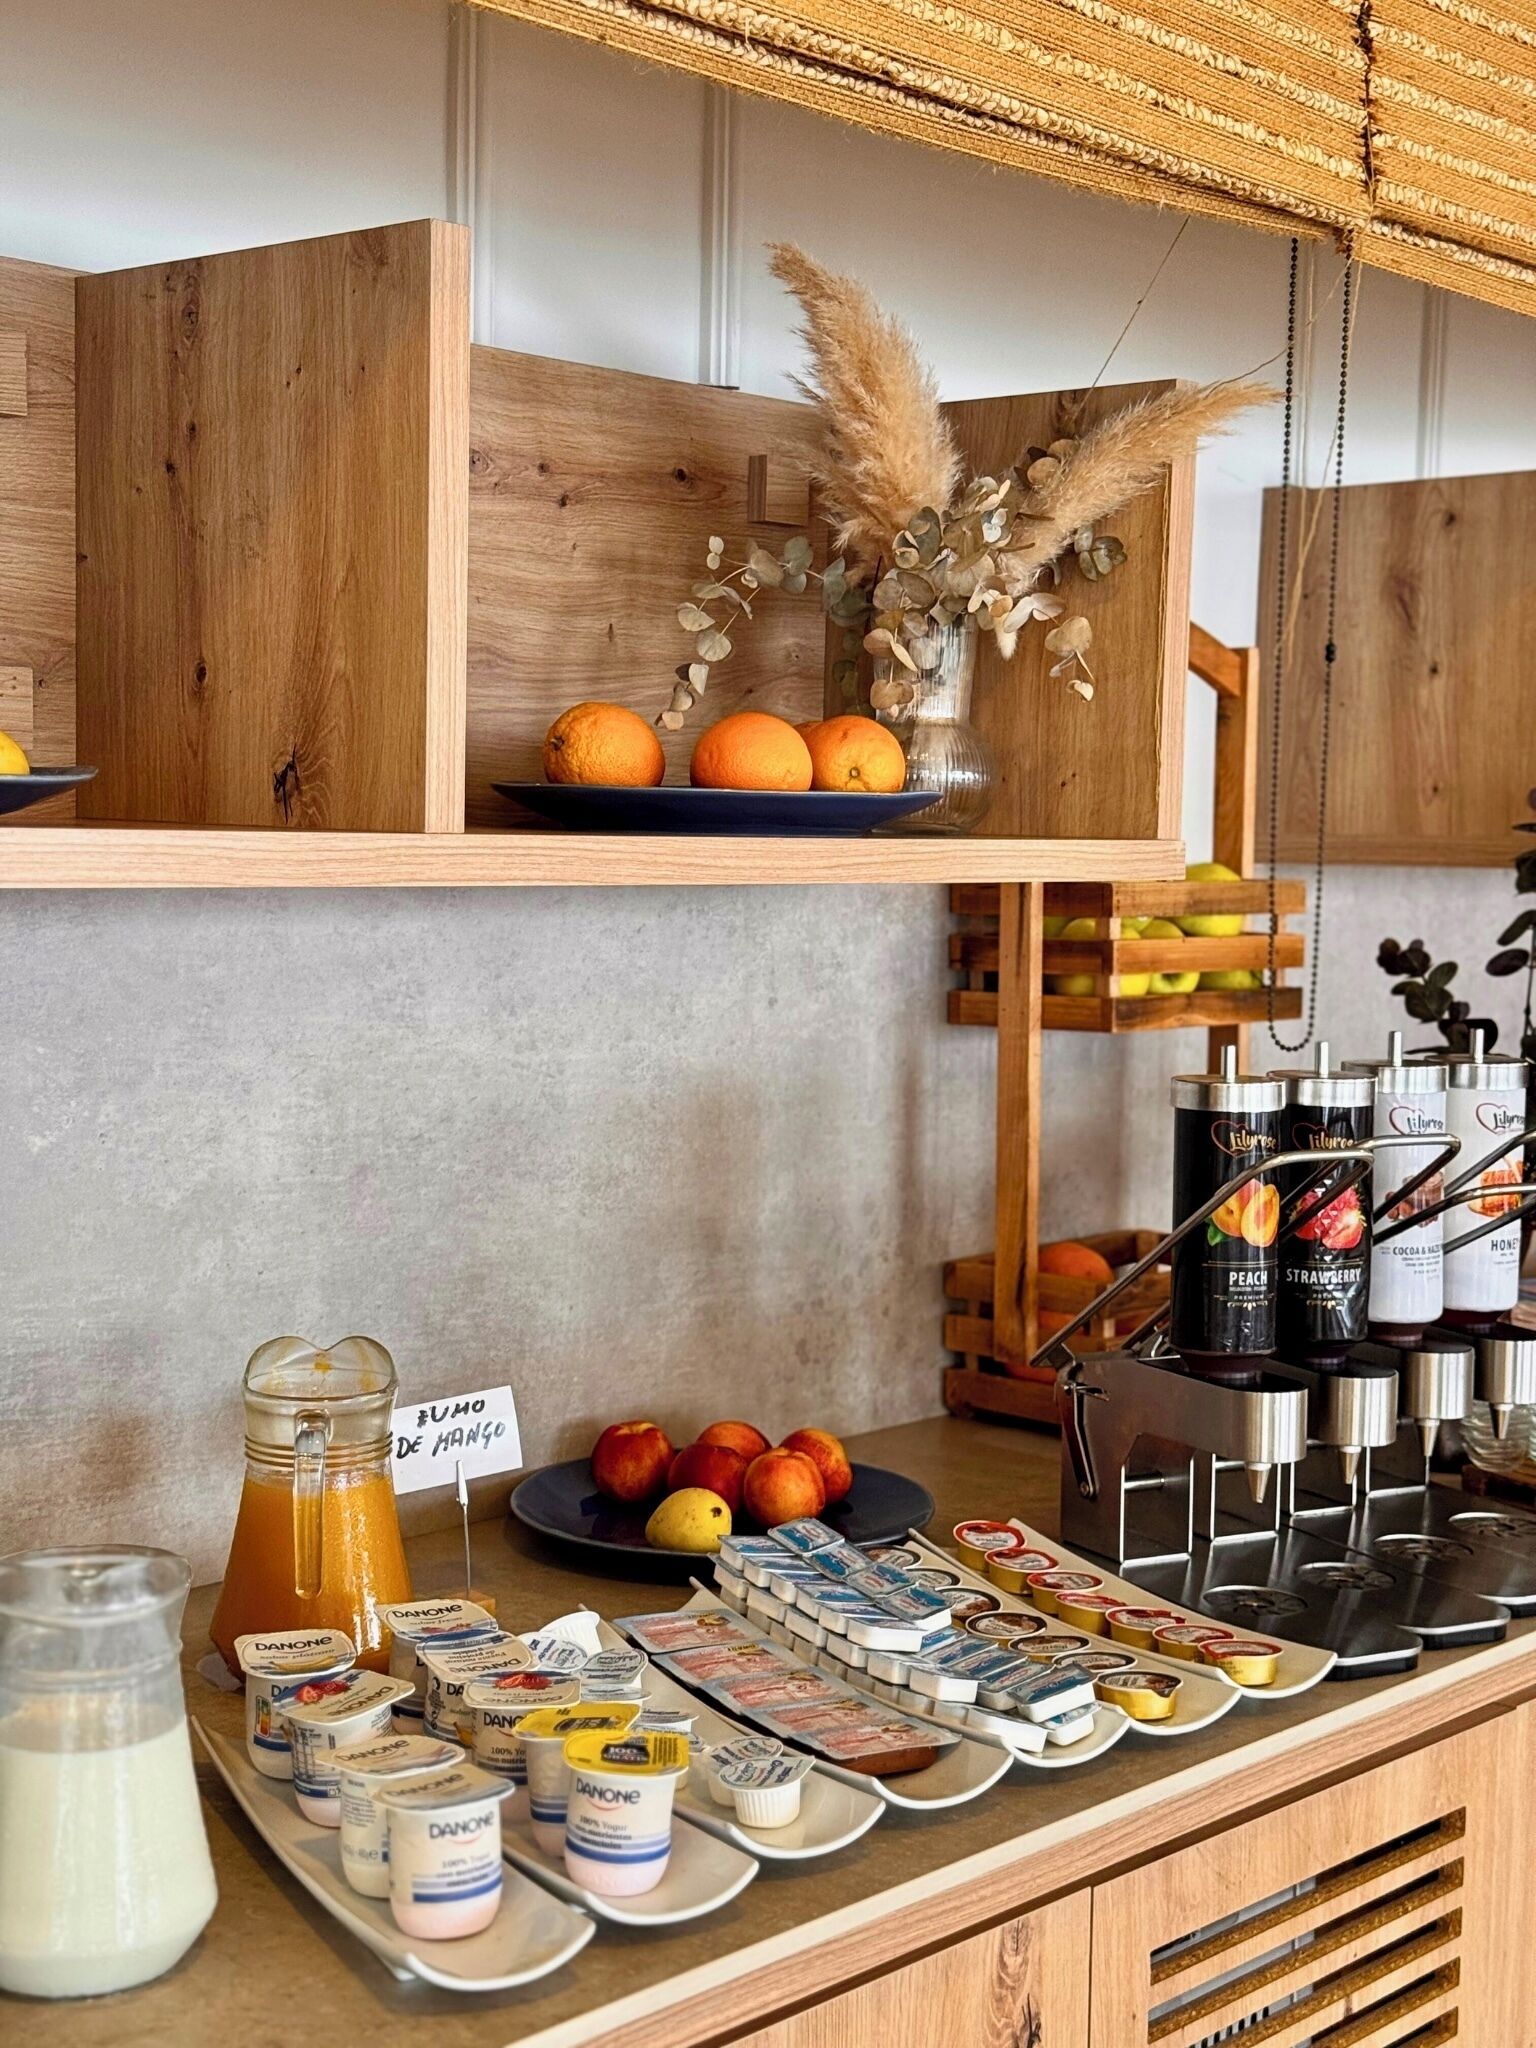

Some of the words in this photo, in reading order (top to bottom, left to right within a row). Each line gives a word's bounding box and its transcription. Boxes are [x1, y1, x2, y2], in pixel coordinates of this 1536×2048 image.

[1229, 1129, 1278, 1151] Lilyrose
[1392, 1246, 1420, 1256] COCOA
[1228, 1270, 1268, 1286] PEACH
[1285, 1268, 1362, 1284] STRAWBERRY
[396, 1435, 424, 1460] DE
[432, 1420, 507, 1458] MANGO
[579, 1815, 601, 1828] 100%
